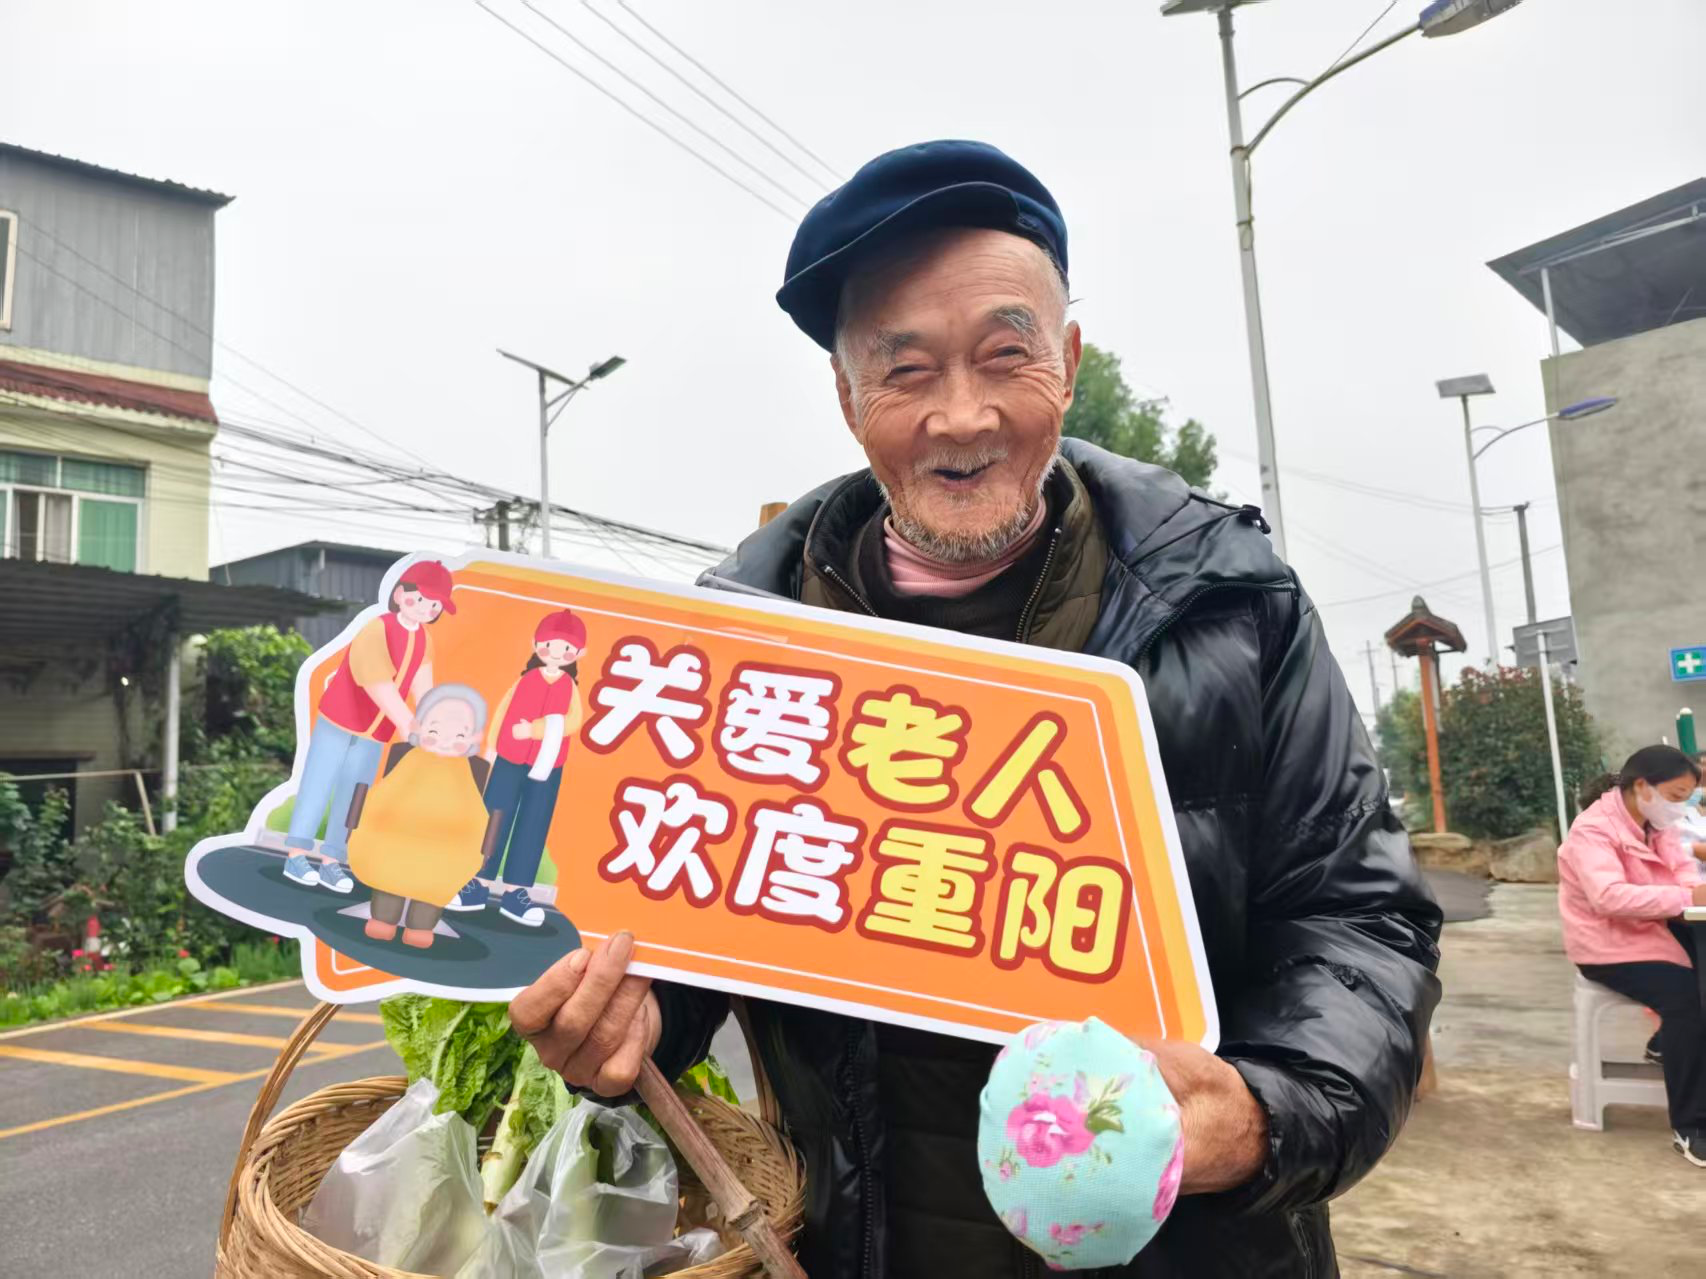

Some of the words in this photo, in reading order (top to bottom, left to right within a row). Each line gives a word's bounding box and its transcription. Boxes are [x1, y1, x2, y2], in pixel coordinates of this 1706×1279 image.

[584, 638, 1088, 838] 关爱老人
[602, 778, 1129, 982] 欢度重阳
